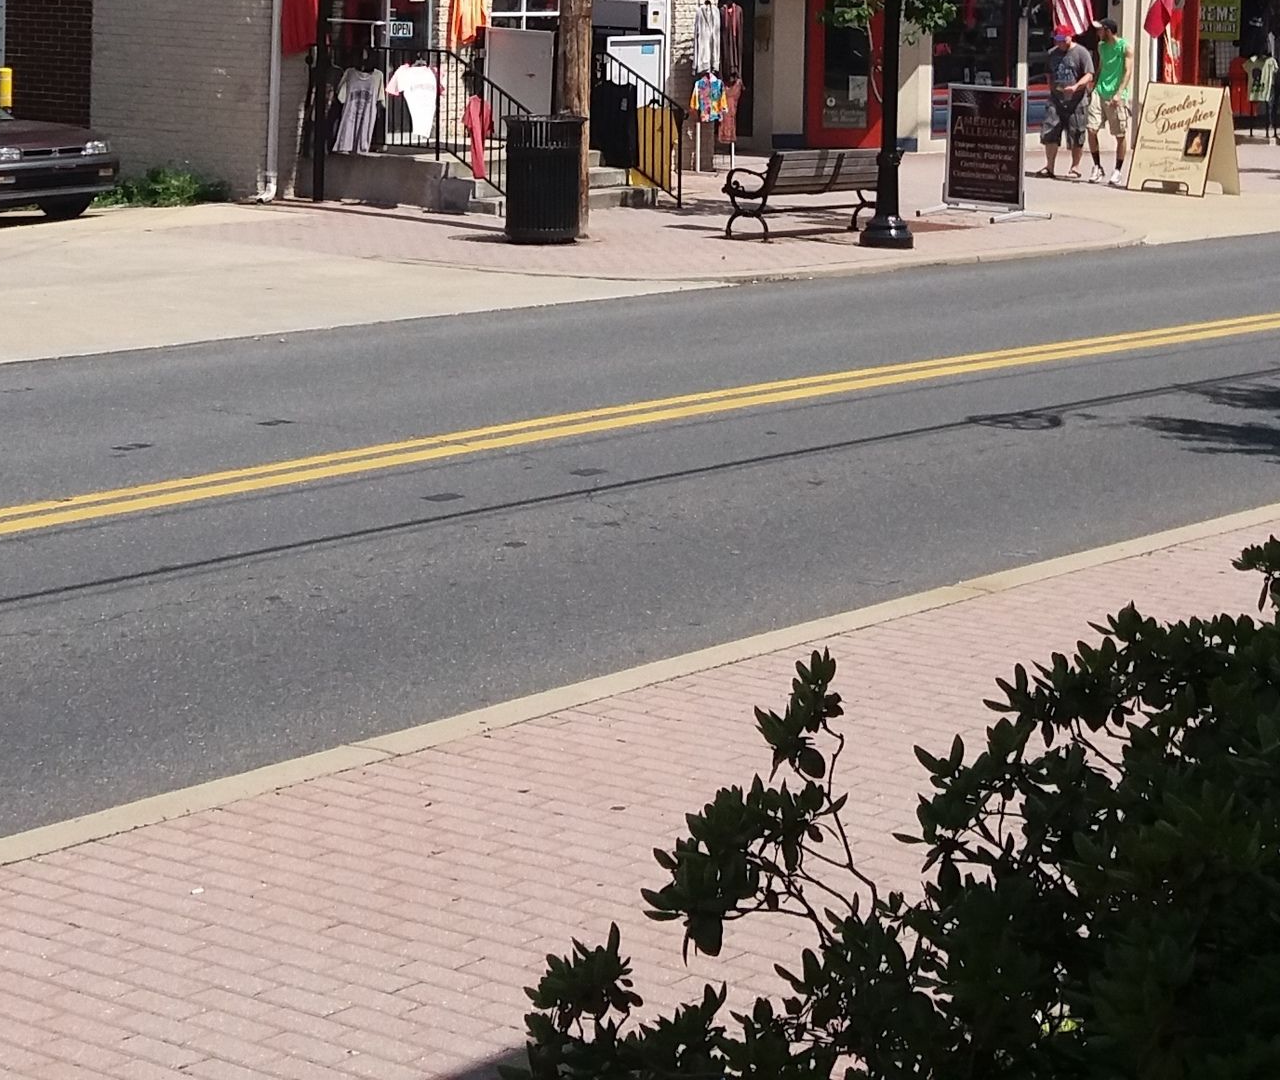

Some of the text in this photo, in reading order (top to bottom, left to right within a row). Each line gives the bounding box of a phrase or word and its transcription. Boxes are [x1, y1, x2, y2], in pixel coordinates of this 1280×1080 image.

[1200, 5, 1237, 22] REME
[392, 22, 412, 36] OPEN
[1145, 90, 1207, 124] Jeweler's
[953, 116, 1016, 131] AMERICAN
[1155, 108, 1216, 136] Daughter
